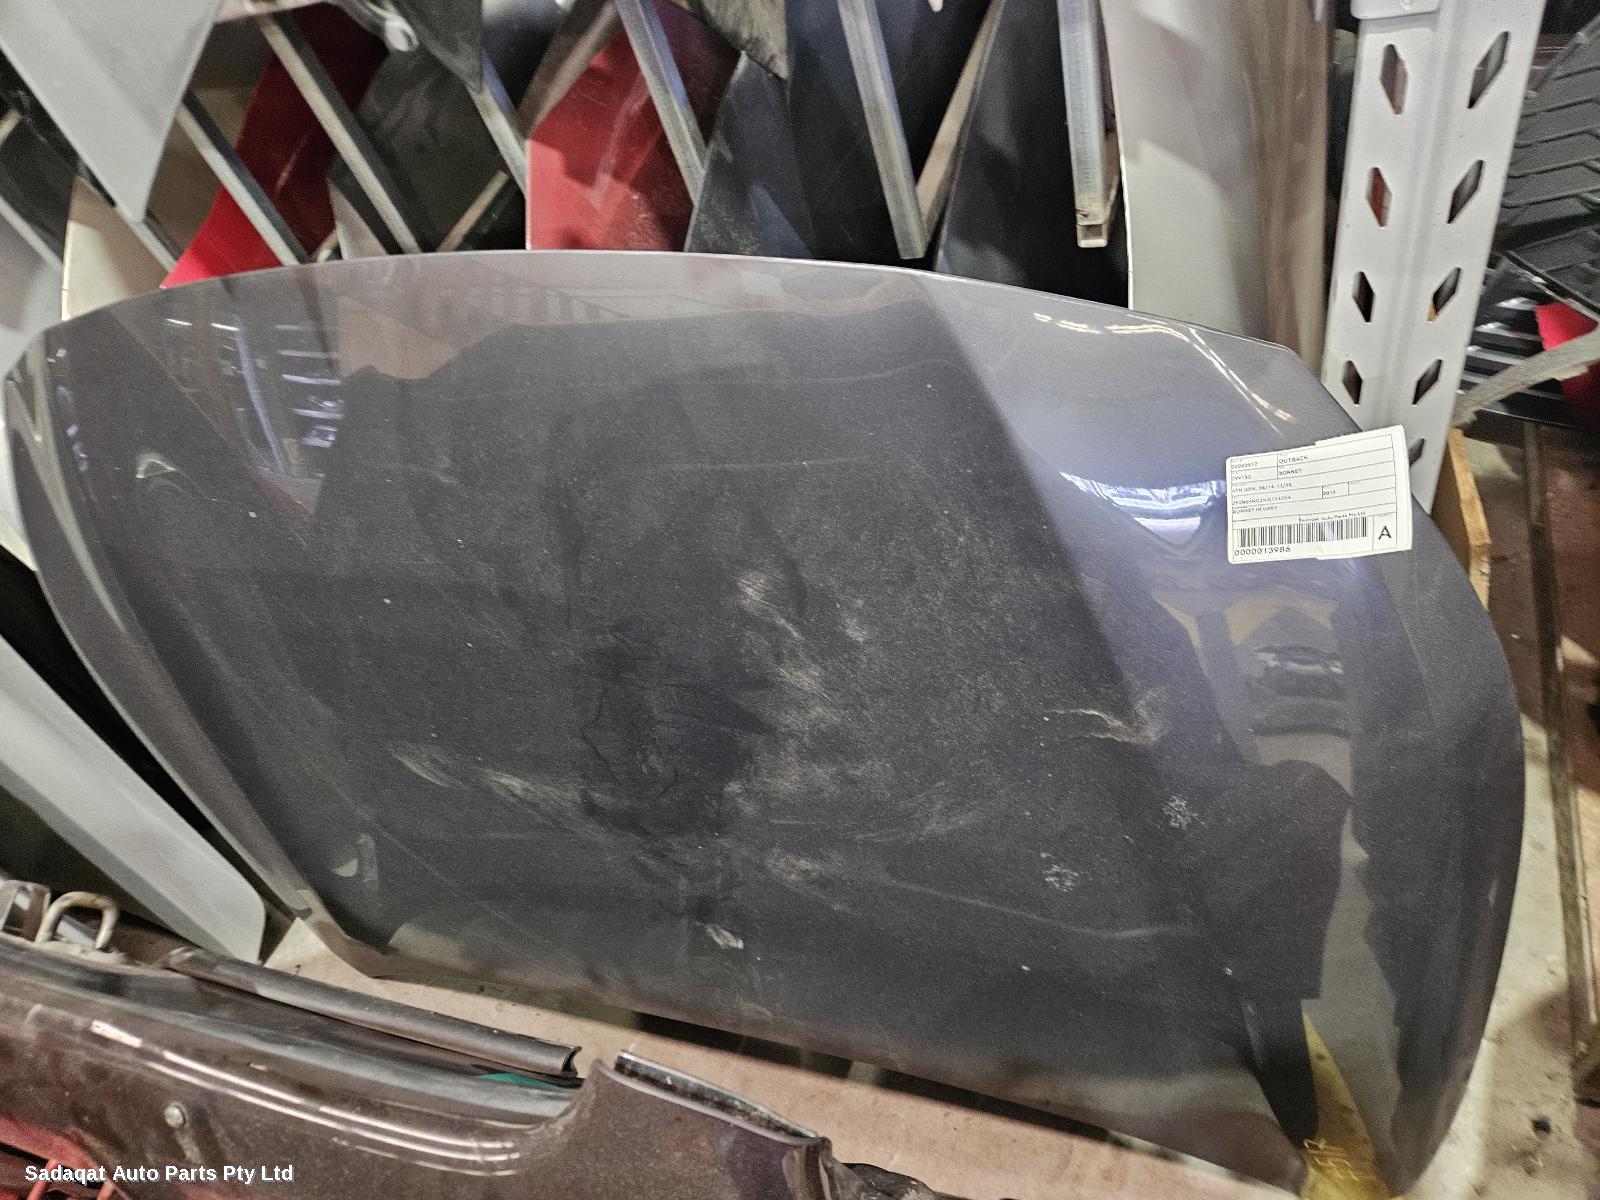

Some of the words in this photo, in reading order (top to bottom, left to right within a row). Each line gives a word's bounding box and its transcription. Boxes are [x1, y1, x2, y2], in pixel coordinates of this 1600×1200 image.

[1279, 455, 1309, 464] OUTBACK
[1378, 525, 1392, 540] A
[1234, 546, 1291, 556] 0000013986
